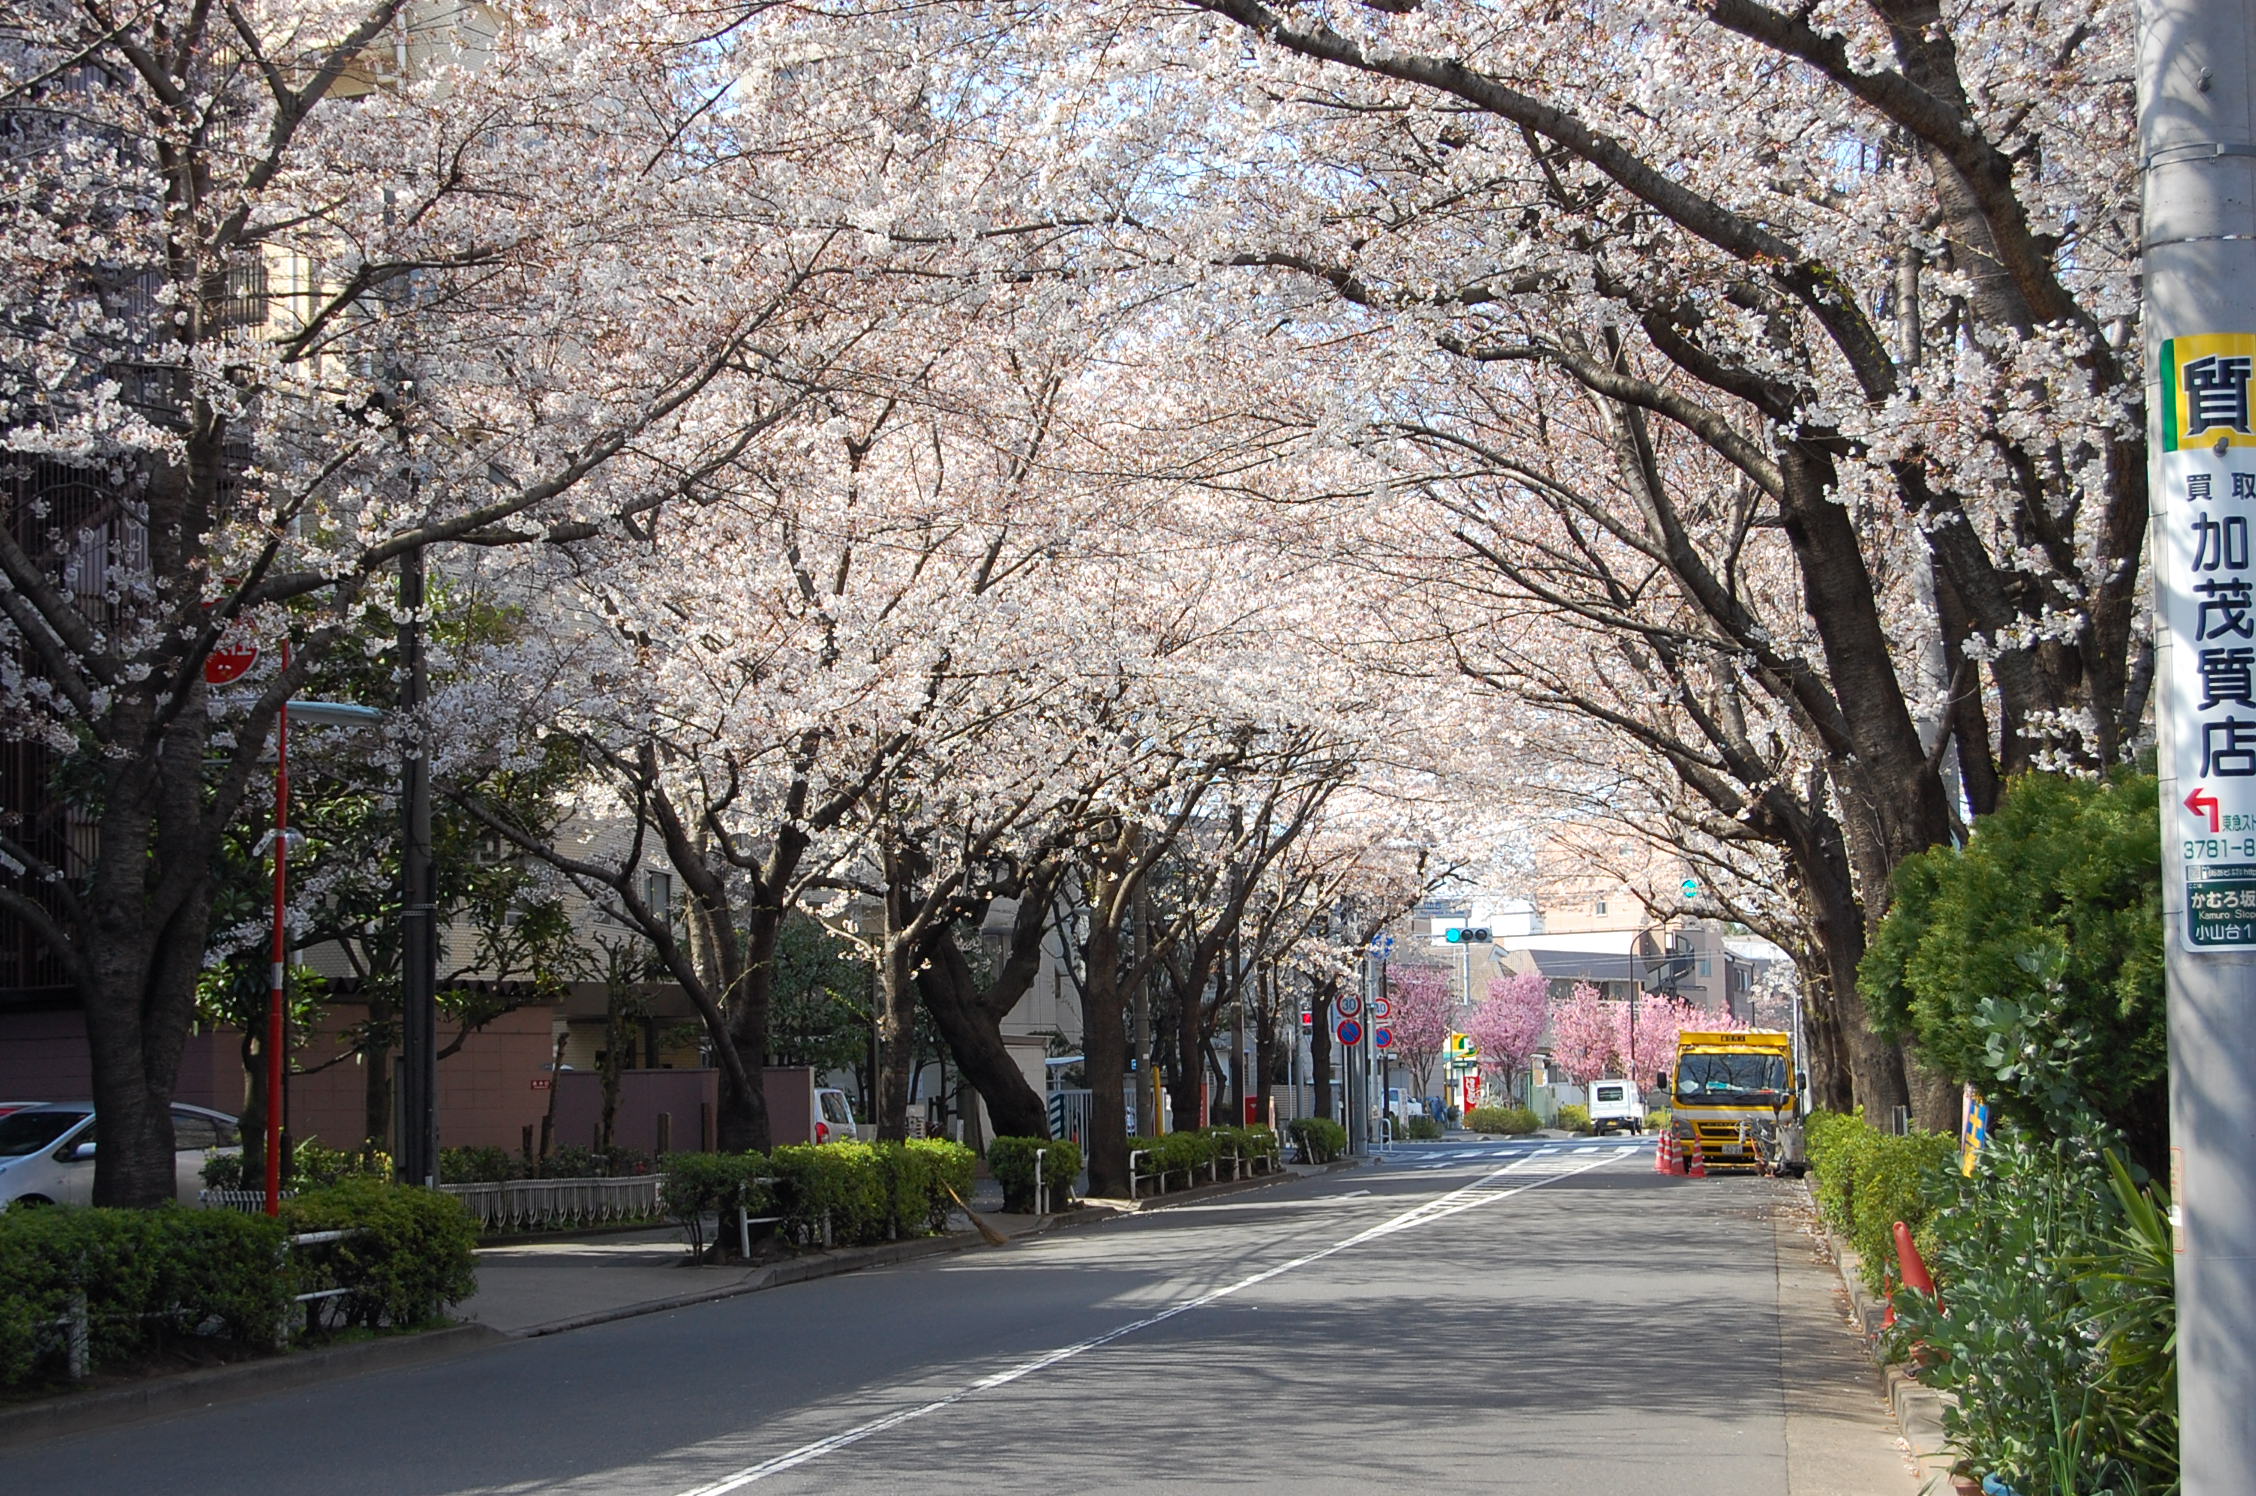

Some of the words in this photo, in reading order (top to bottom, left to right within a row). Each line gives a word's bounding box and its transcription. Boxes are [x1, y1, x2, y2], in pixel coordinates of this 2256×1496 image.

[2183, 354, 2253, 437] 質
[2186, 472, 2256, 500] 買取
[2191, 511, 2256, 778] 加茂質店
[2184, 838, 2255, 859] 3781-8
[2191, 890, 2256, 909] かむろ坂
[2199, 911, 2230, 920] Kamuro
[1342, 998, 1357, 1011] 30
